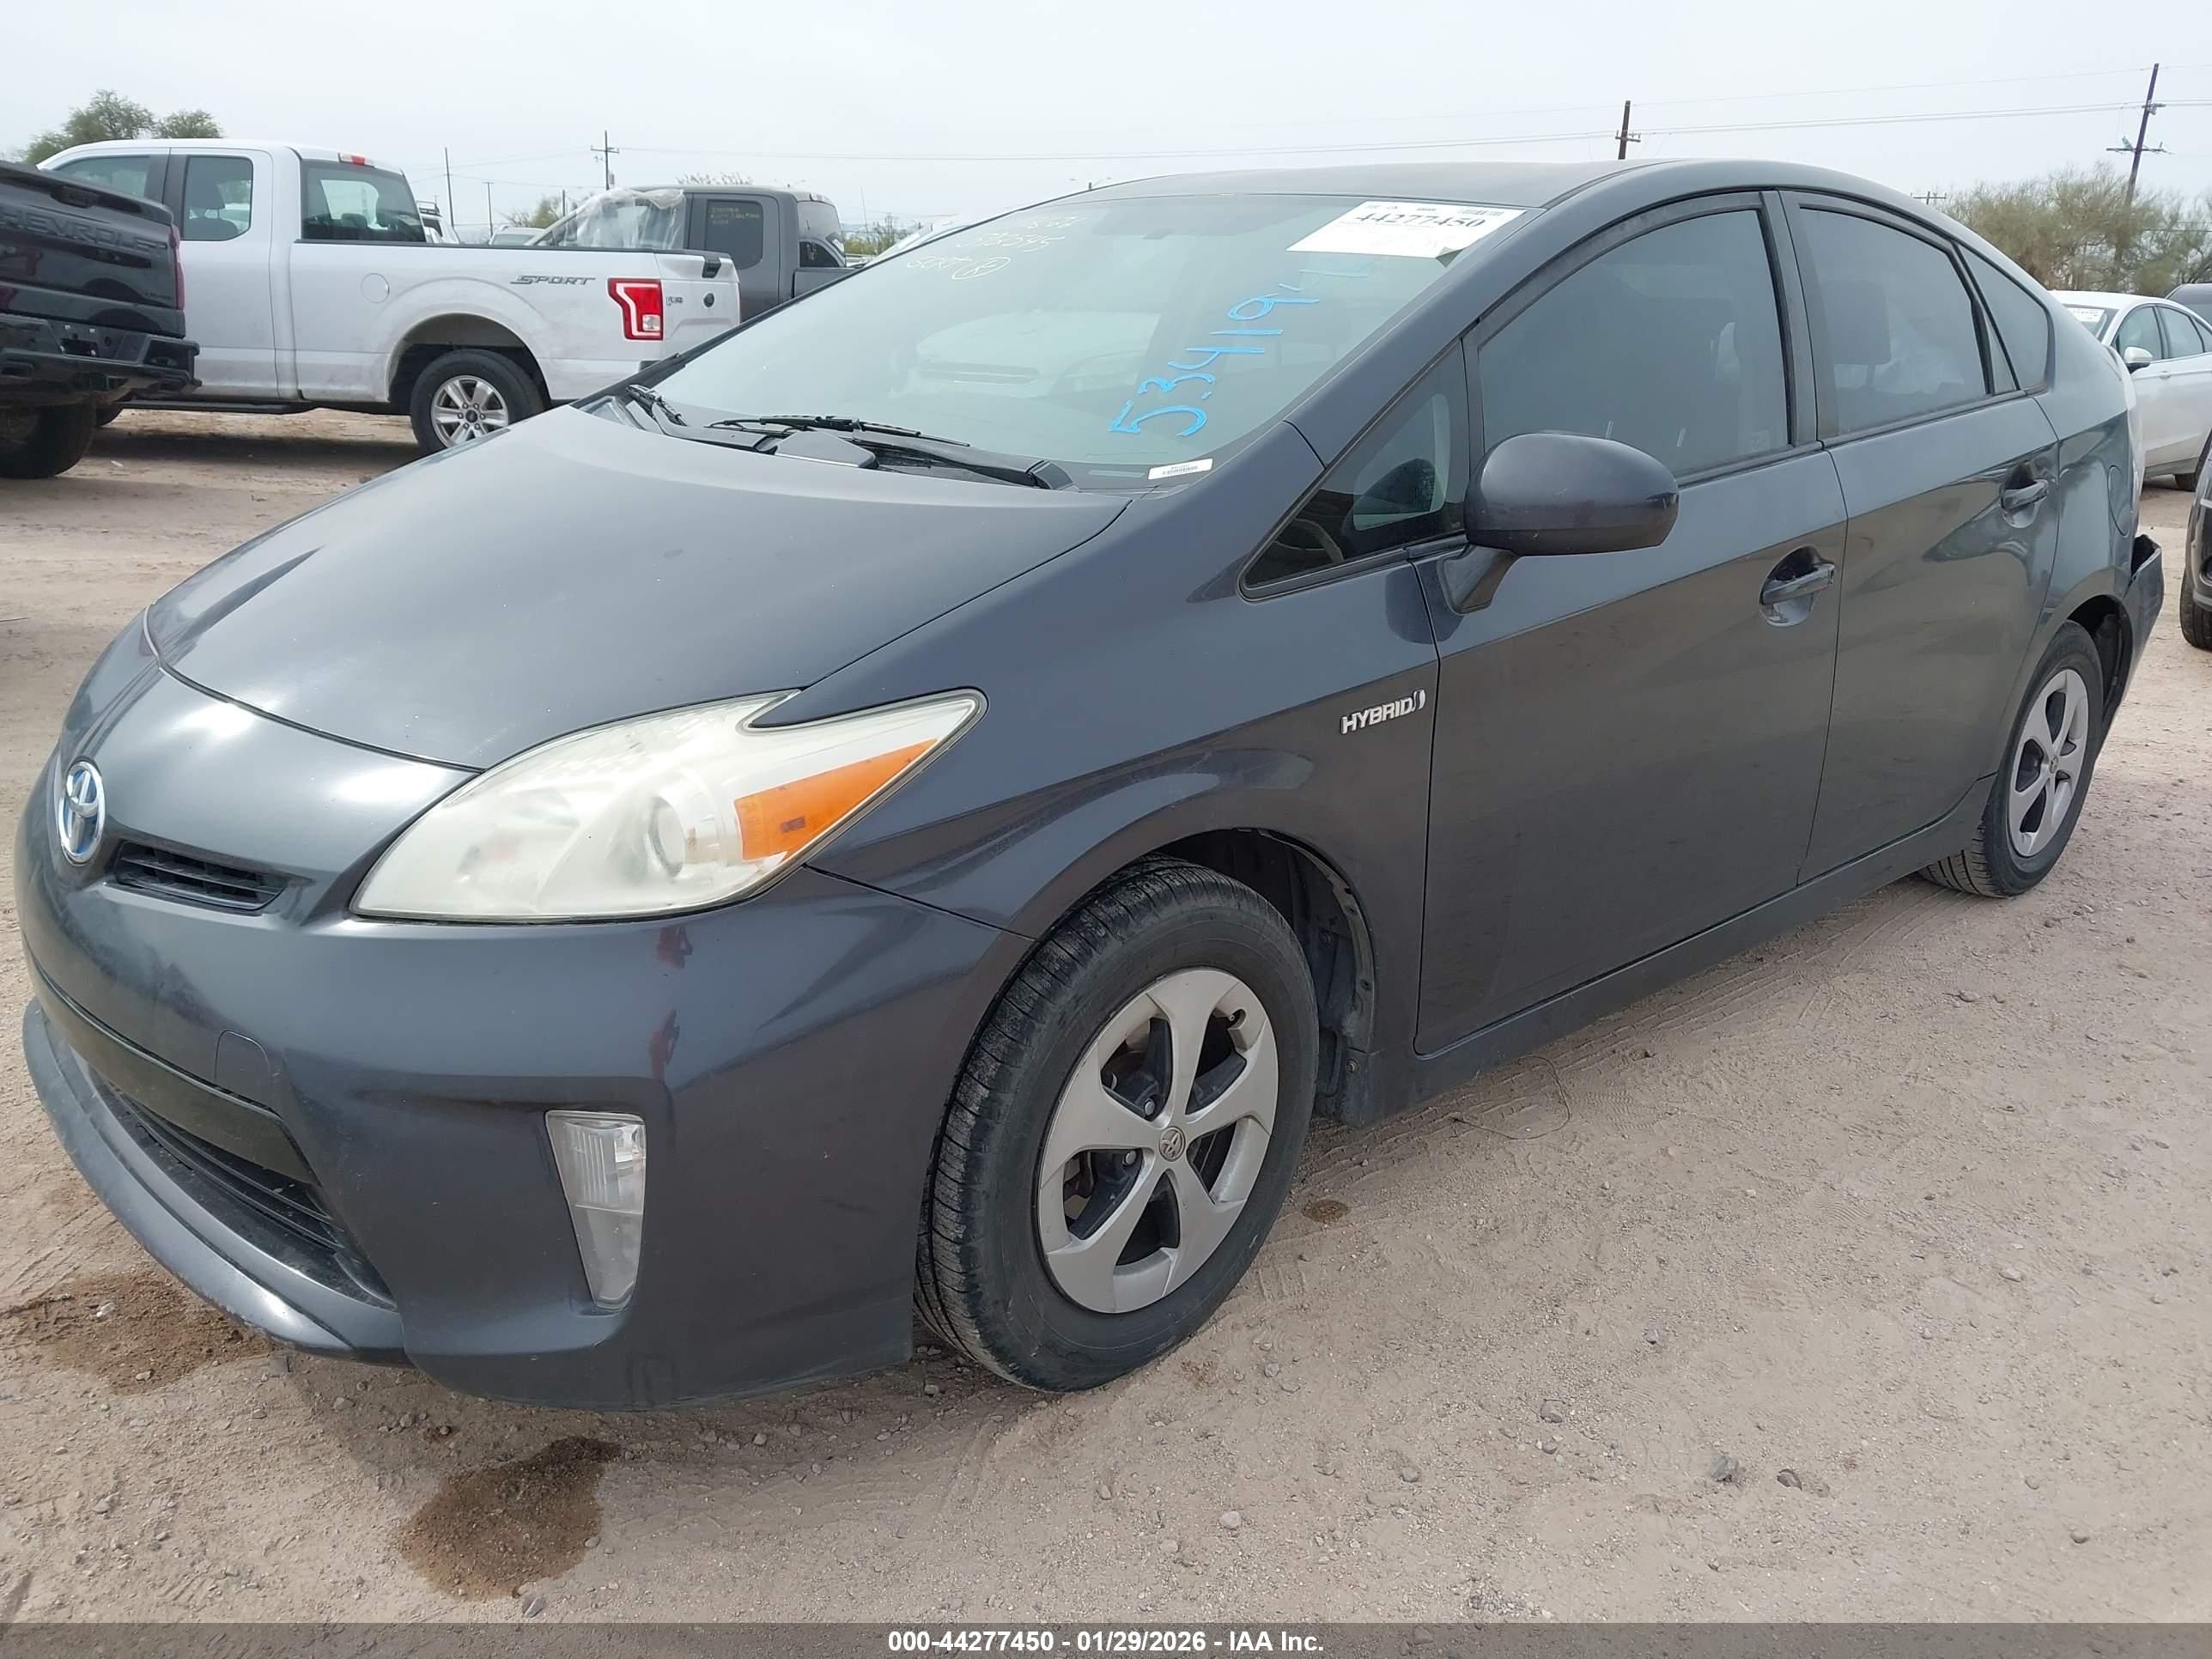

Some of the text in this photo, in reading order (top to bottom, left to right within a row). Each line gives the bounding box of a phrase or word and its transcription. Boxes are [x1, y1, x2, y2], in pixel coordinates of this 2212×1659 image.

[0, 205, 168, 255] HEVROLET
[1356, 212, 1486, 228] 44277450
[509, 275, 596, 285] SPORT
[1341, 696, 1415, 734] HYBRID
